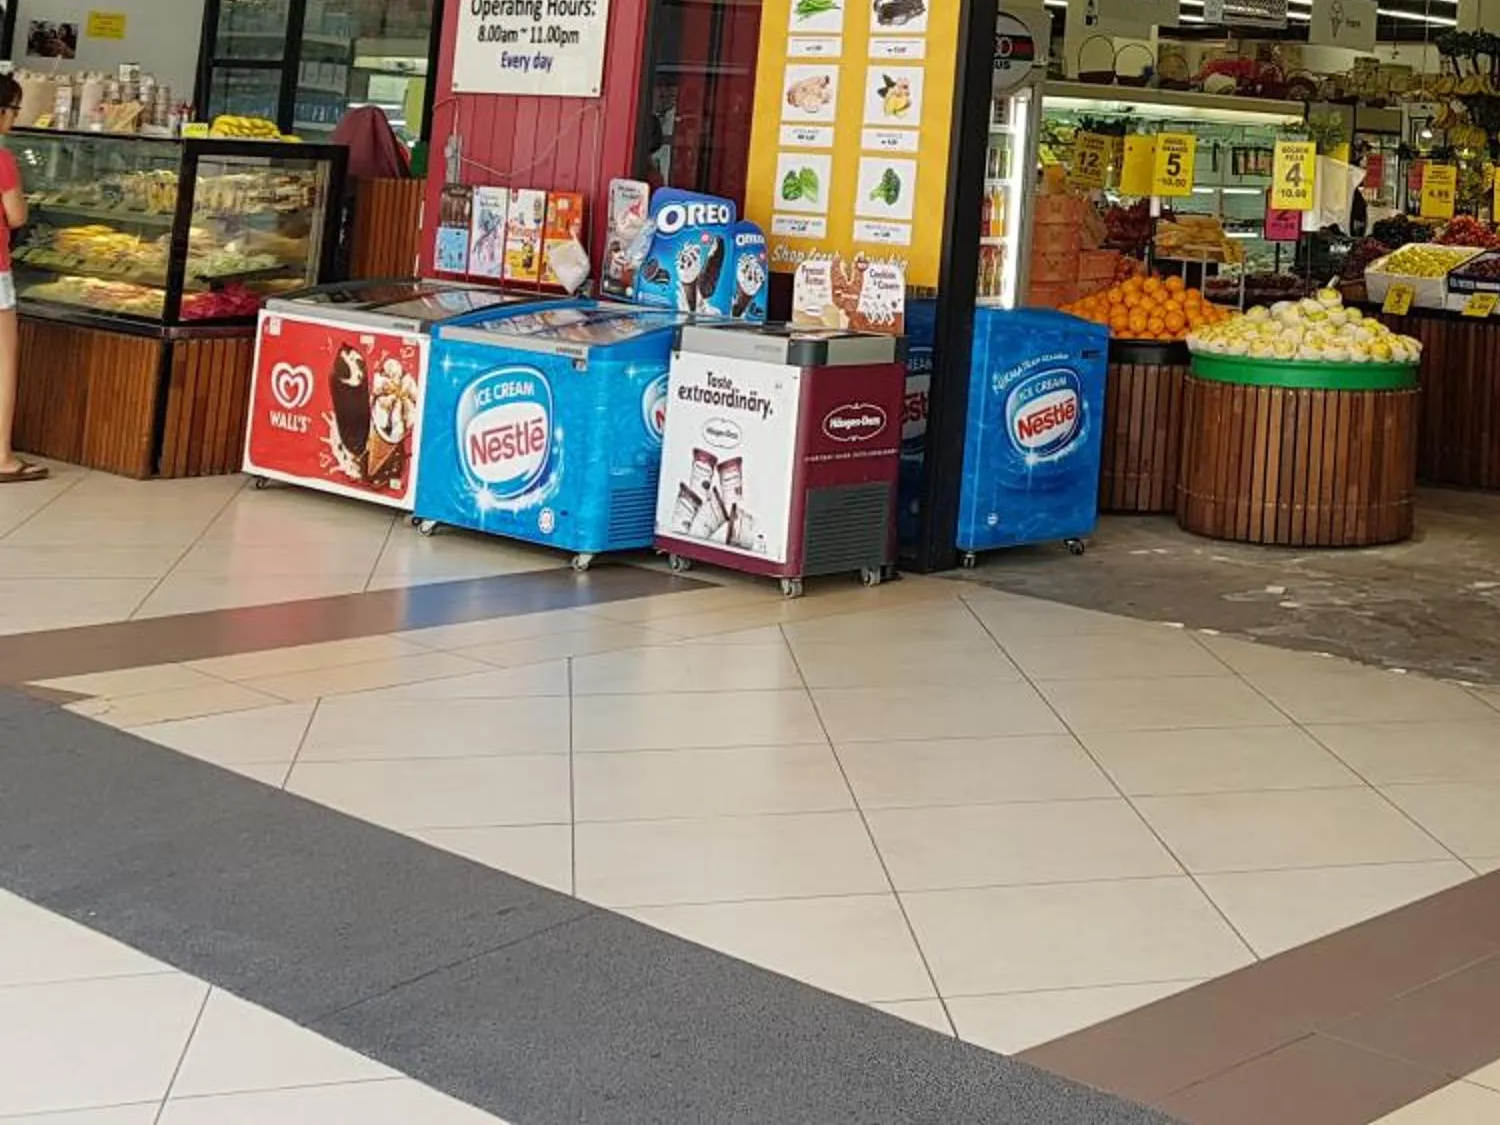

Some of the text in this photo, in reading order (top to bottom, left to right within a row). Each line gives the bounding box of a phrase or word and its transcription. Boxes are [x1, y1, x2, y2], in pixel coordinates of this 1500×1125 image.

[477, 24, 519, 43] 8.00am
[529, 25, 580, 47] 11.00pm
[500, 50, 554, 73] Every day
[1166, 152, 1182, 177] 5
[1285, 162, 1302, 188] 4
[656, 203, 730, 234] OREO
[706, 370, 733, 389] Taste
[1034, 375, 1067, 393] CREAM
[473, 382, 535, 406] ICE CREAM
